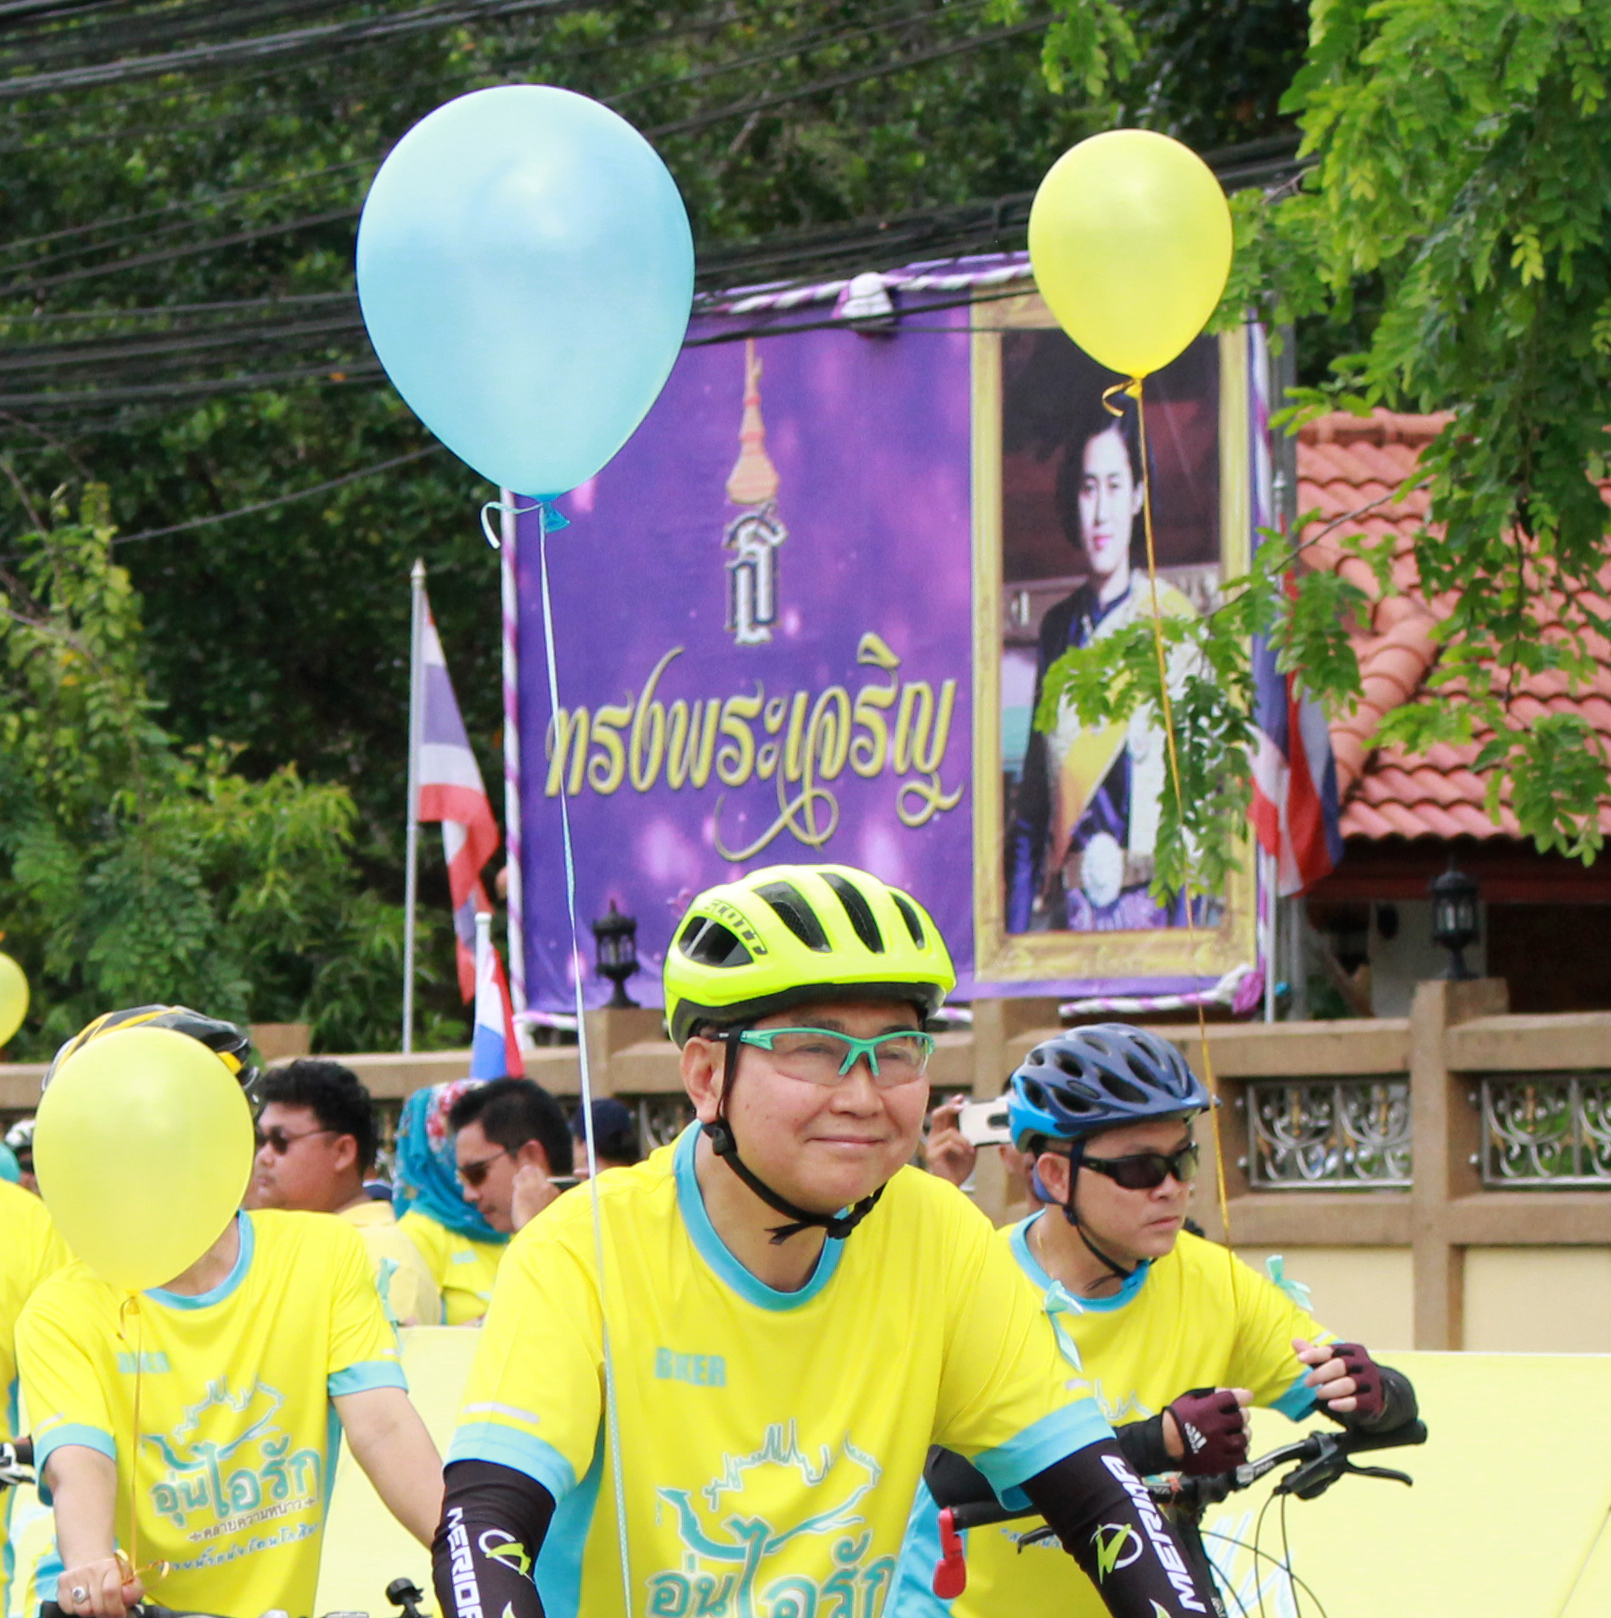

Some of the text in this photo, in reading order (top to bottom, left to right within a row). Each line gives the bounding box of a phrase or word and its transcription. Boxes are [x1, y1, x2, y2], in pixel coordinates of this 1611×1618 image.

[544, 633, 964, 863] ทรงพระเจริญ
[152, 1434, 321, 1527] อุ่นไอรัก
[1100, 1454, 1207, 1614] MERIDA
